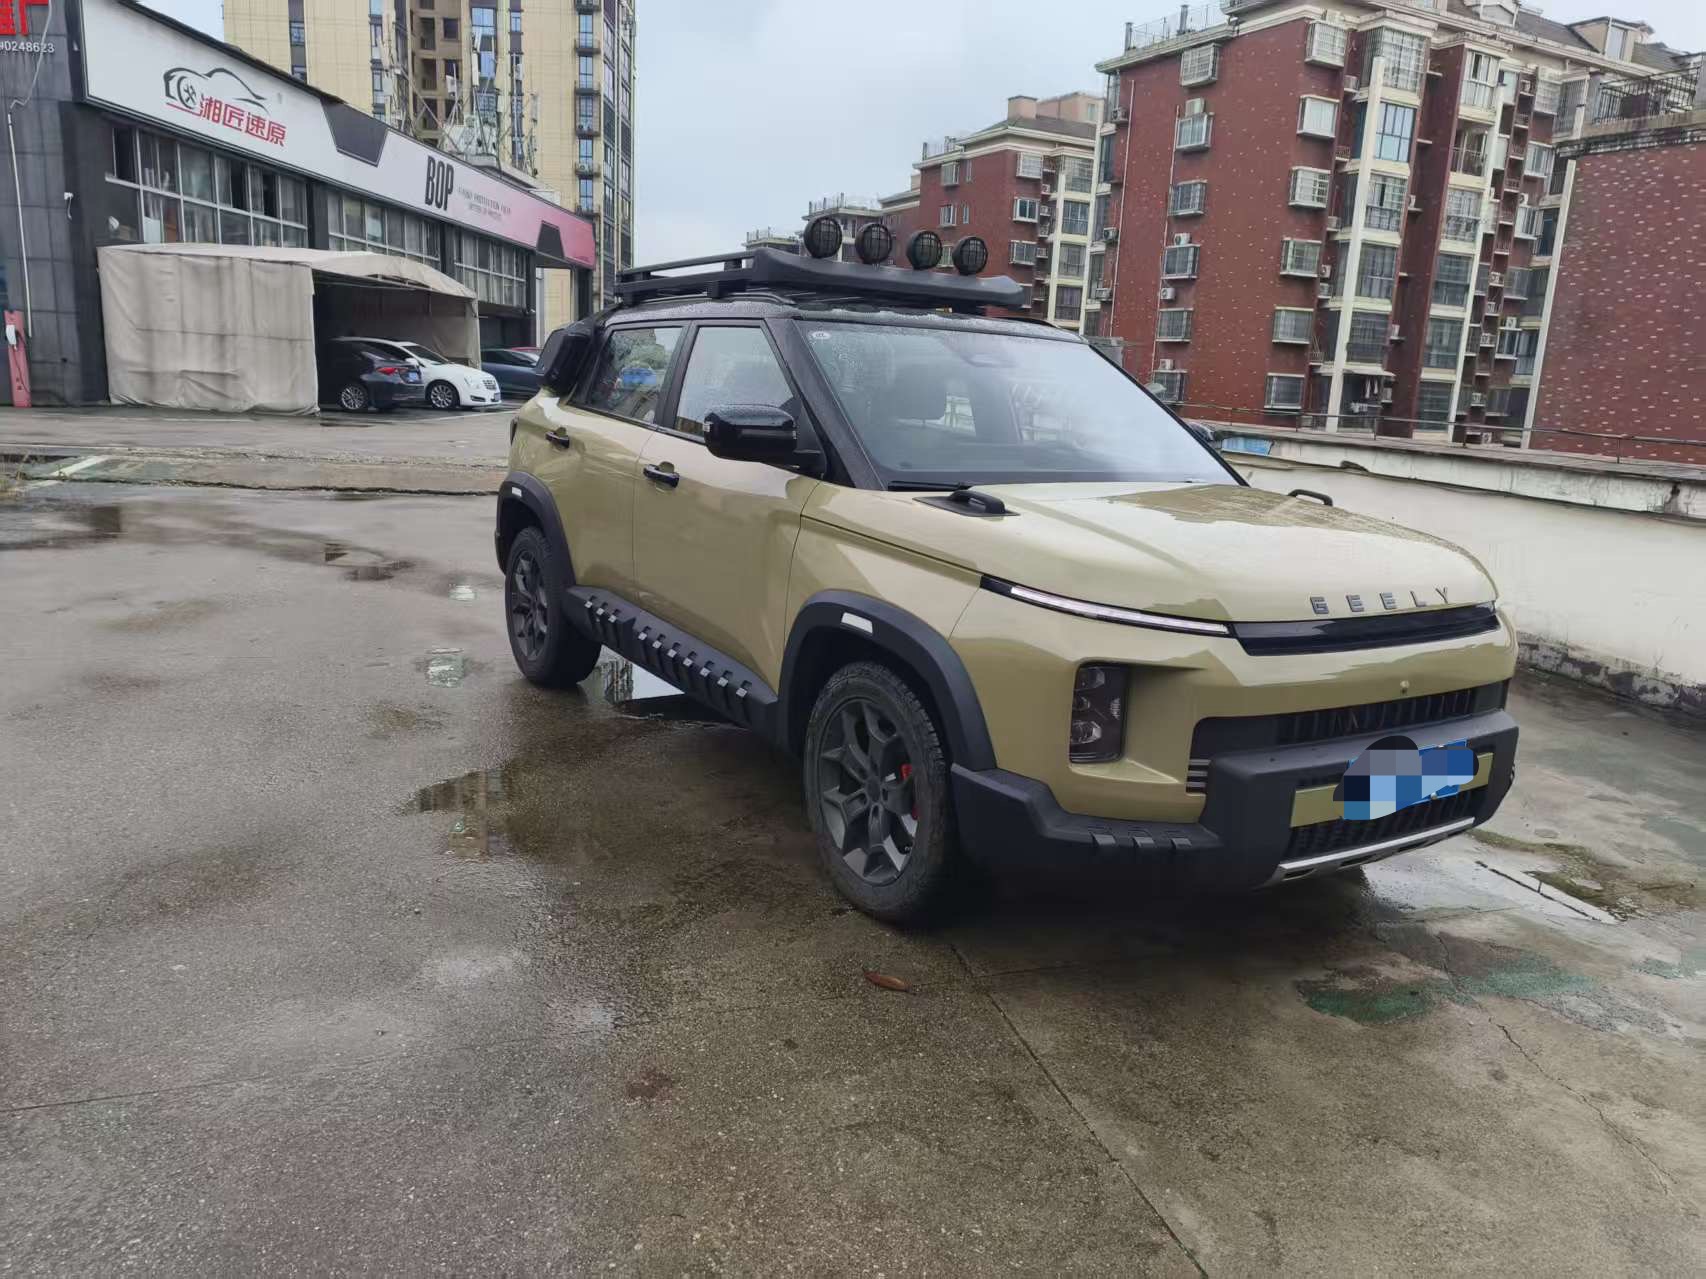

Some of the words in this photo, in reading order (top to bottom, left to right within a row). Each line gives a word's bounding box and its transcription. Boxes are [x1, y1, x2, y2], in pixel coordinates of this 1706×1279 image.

[200, 93, 287, 147] 湘匠速原
[425, 155, 454, 211] BOP
[1310, 586, 1450, 614] GEELY
